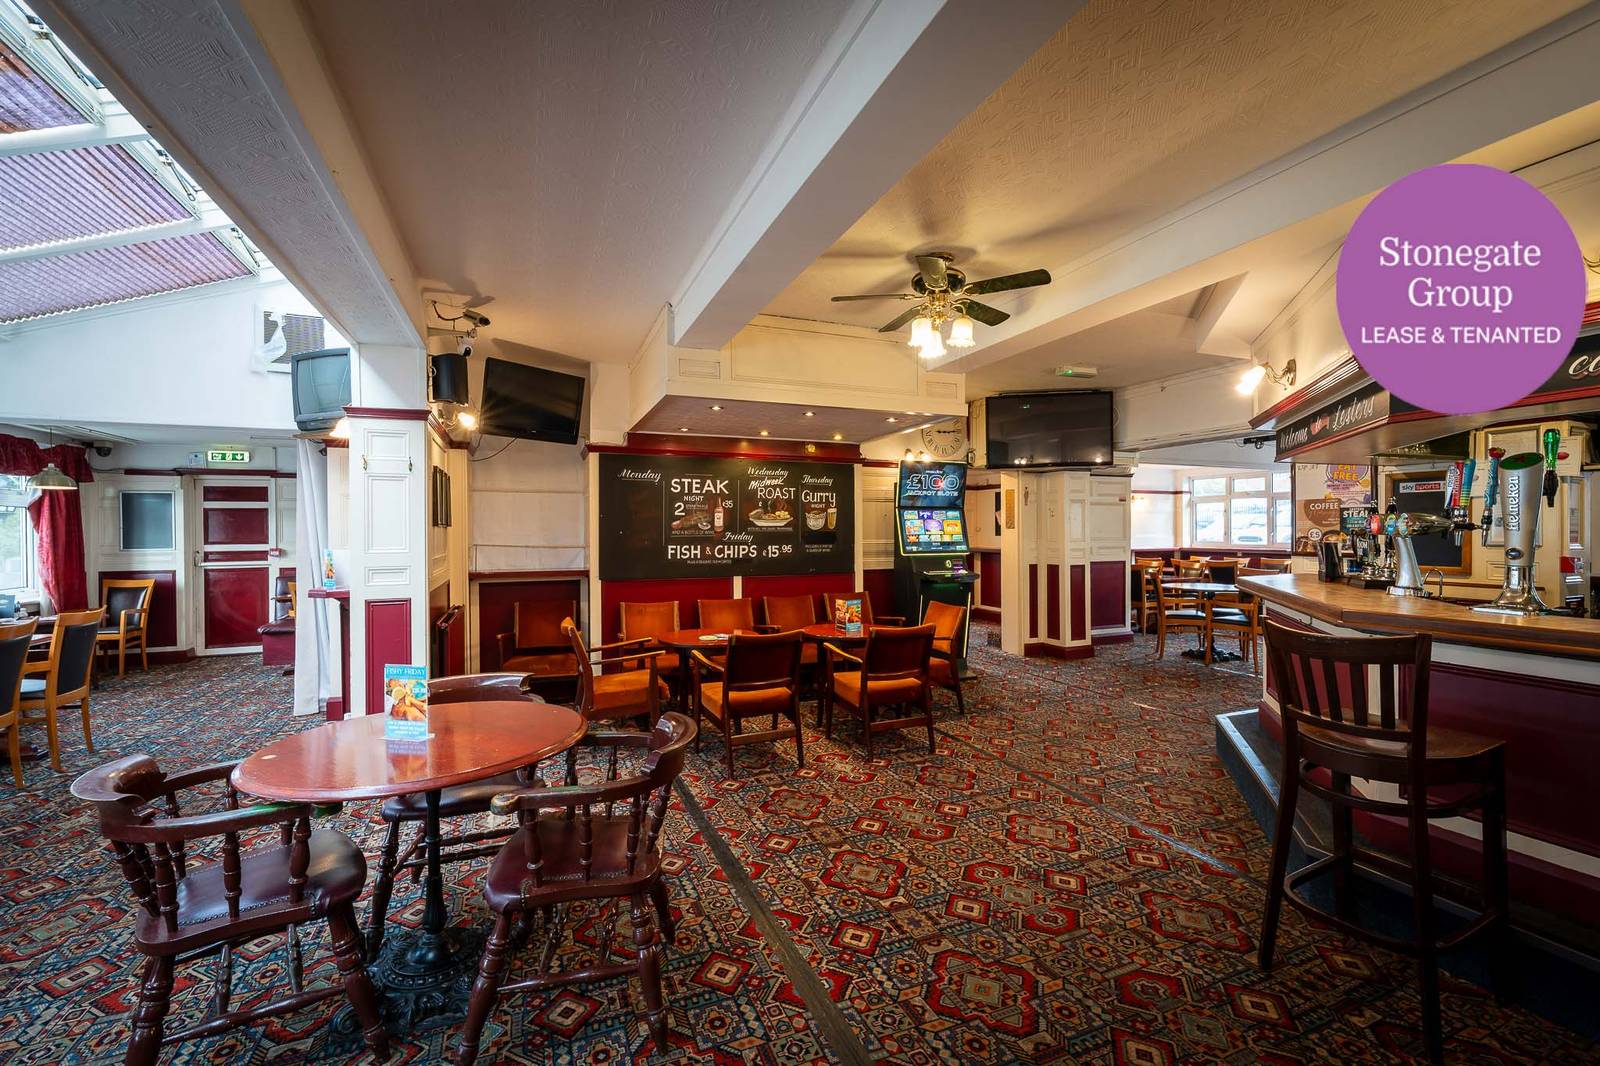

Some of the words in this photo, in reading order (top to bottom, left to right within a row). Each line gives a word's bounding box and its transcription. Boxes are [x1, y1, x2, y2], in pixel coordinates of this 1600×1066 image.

[617, 468, 662, 483] Monday
[747, 466, 789, 479] Wednesday
[1333, 471, 1360, 481] FREE
[670, 478, 729, 494] STEAK
[748, 476, 785, 490] Midweek
[801, 474, 834, 486] Thursday
[906, 474, 960, 490] £100
[757, 487, 796, 500] ROAST
[1402, 483, 1414, 493] sky
[1416, 482, 1441, 492] sports
[674, 502, 686, 516] 2
[1508, 475, 1520, 531] Heineken
[723, 531, 754, 543] Friday
[667, 545, 701, 559] FISH
[705, 547, 712, 555] &
[714, 545, 757, 559] CHIPS
[404, 667, 425, 675] FRIDAY
